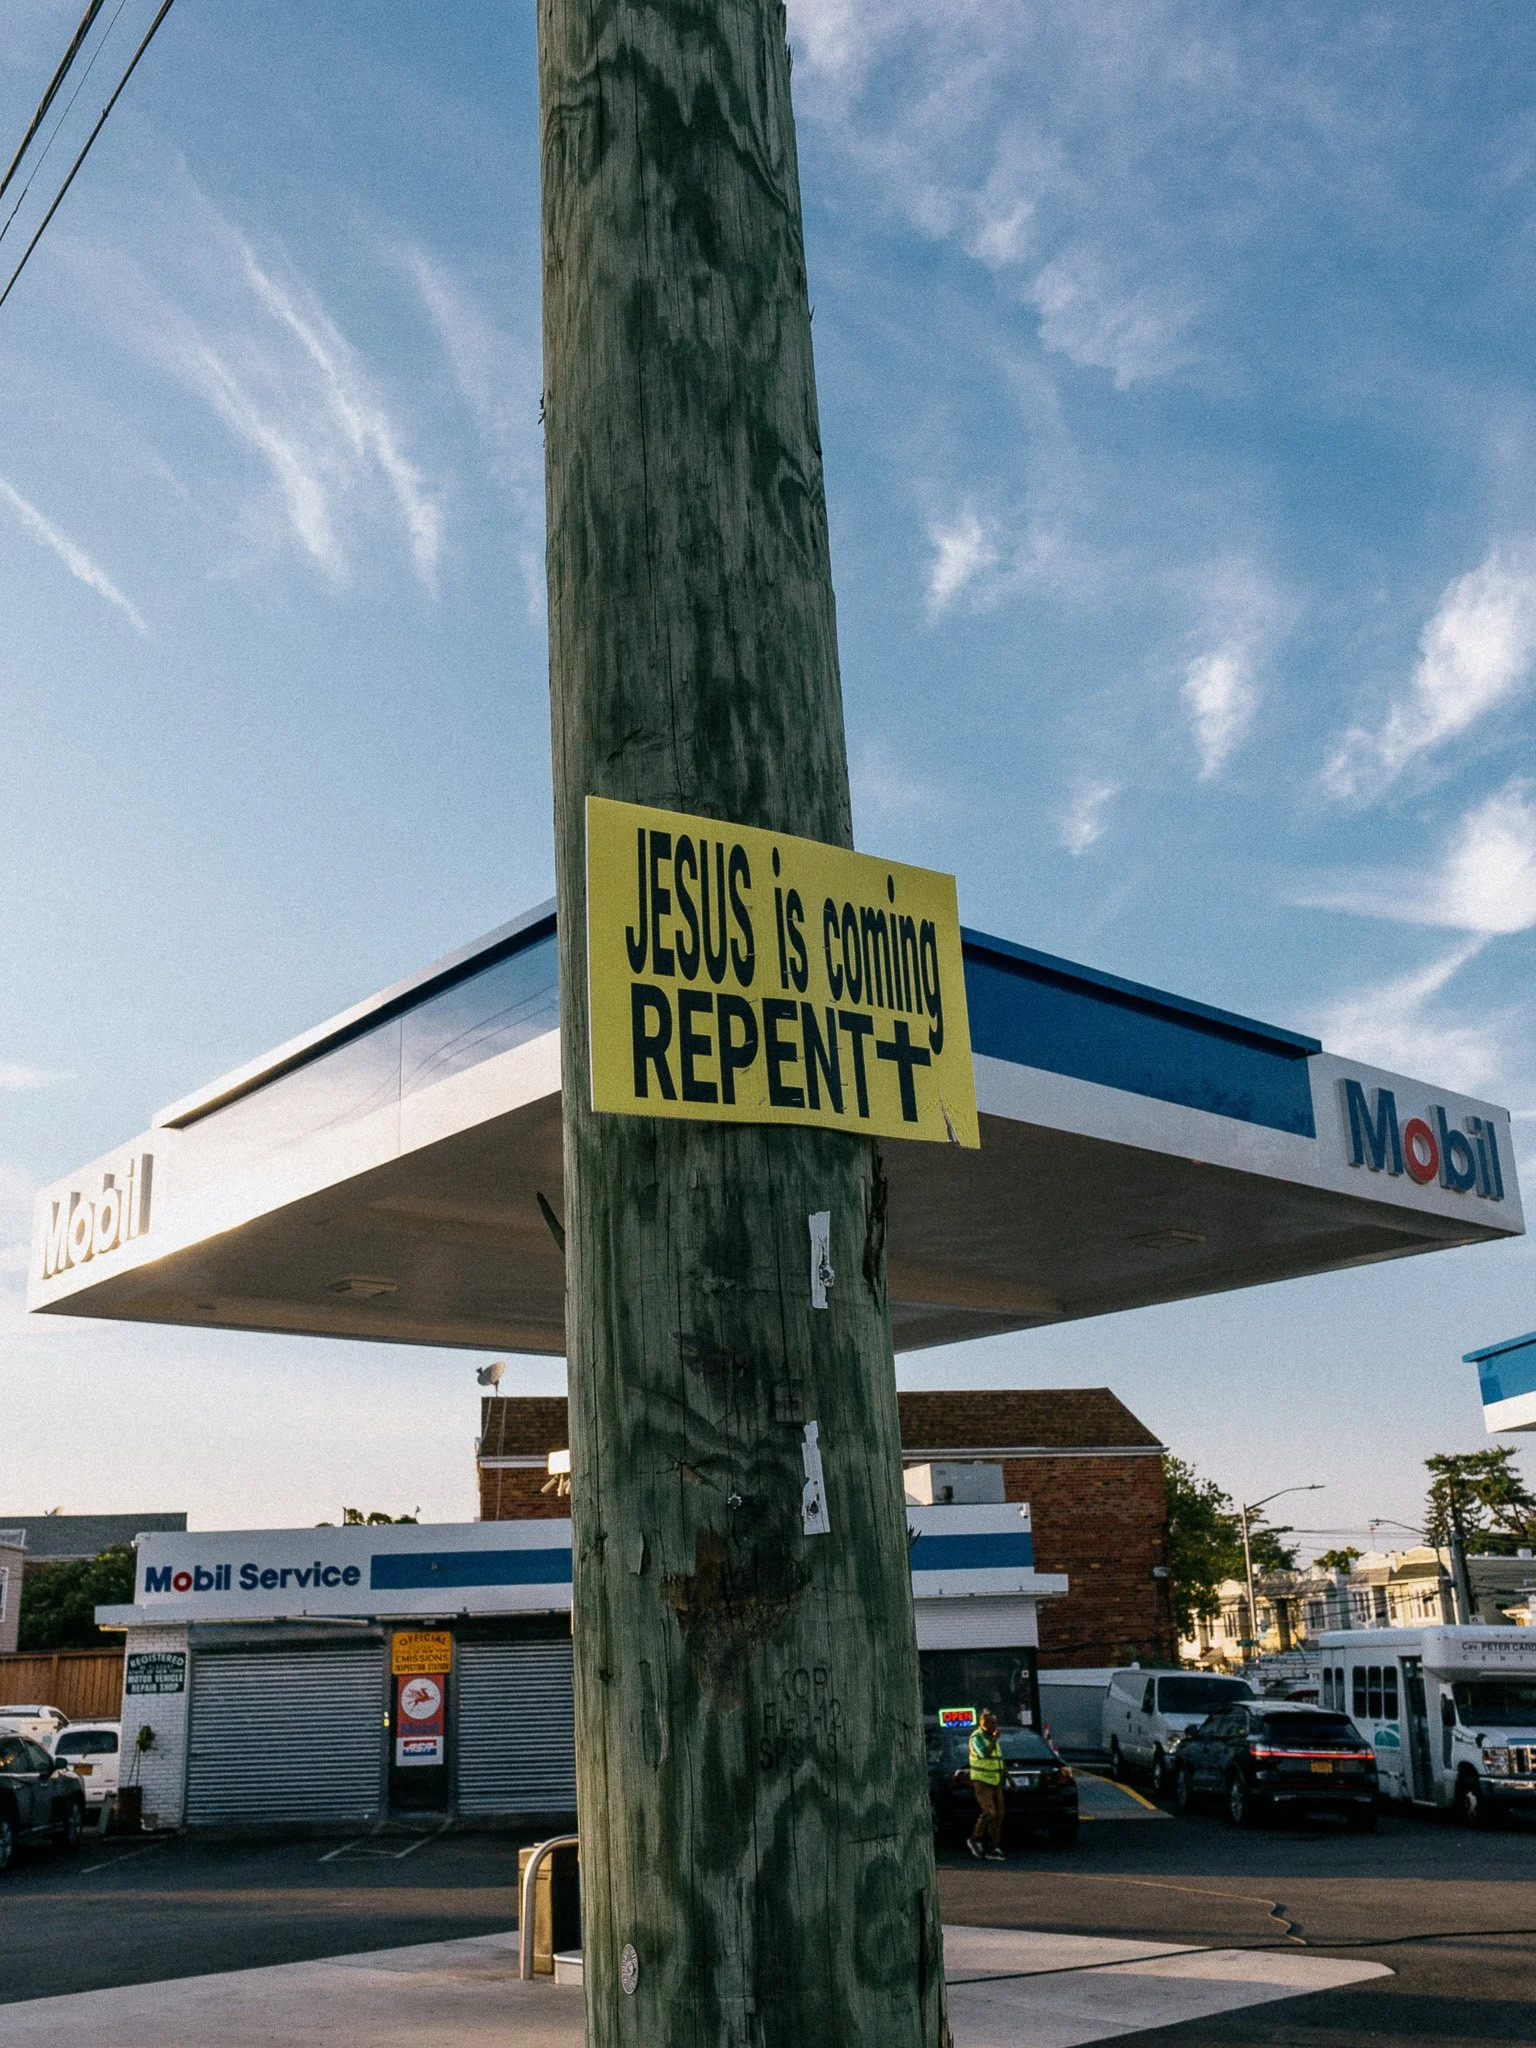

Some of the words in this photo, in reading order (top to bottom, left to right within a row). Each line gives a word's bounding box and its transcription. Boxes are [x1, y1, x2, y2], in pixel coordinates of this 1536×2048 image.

[625, 828, 756, 988] JESUS
[771, 846, 809, 993] is
[823, 874, 944, 1056] coming
[630, 983, 874, 1119] REPENT
[1336, 1077, 1505, 1202] Mobil
[41, 1152, 153, 1281] Mobil
[145, 1564, 232, 1592] Mobil
[239, 1561, 361, 1590] Service
[399, 1632, 447, 1646] OFFICIAL
[1481, 1641, 1510, 1652] PETER
[130, 1653, 184, 1668] REGISTERED
[395, 1654, 449, 1663] EMISSIONS
[127, 1674, 152, 1684] MOTOR
[154, 1673, 183, 1683] VEHICLE
[131, 1683, 157, 1692] REPAIR
[943, 1711, 973, 1721] OPEN
